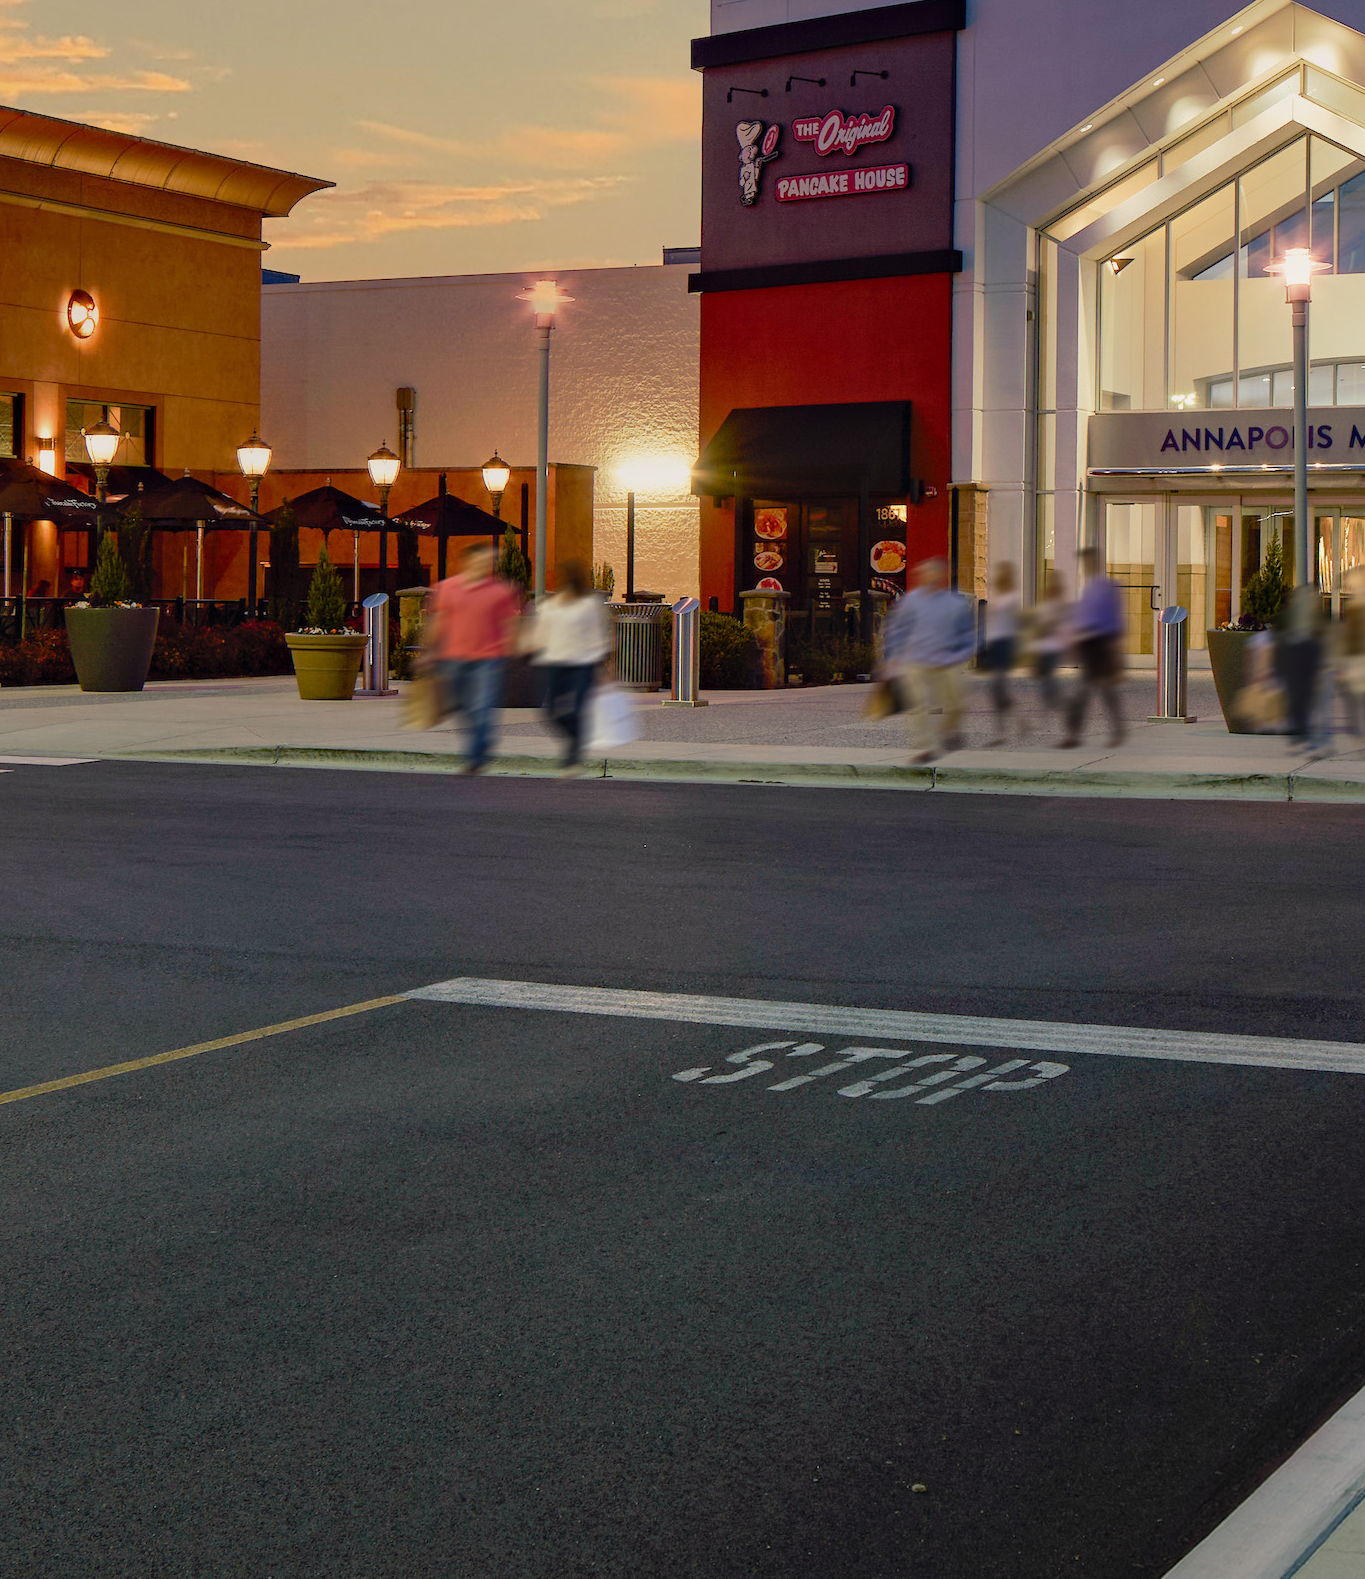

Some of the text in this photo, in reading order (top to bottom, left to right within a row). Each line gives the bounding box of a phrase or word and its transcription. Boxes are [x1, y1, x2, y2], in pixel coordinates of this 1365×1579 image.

[795, 109, 891, 152] THE Original
[777, 166, 906, 199] PANCAKE HOUSE
[1160, 424, 1333, 452] ANNAPOIS
[671, 1040, 1071, 1105] STOP
